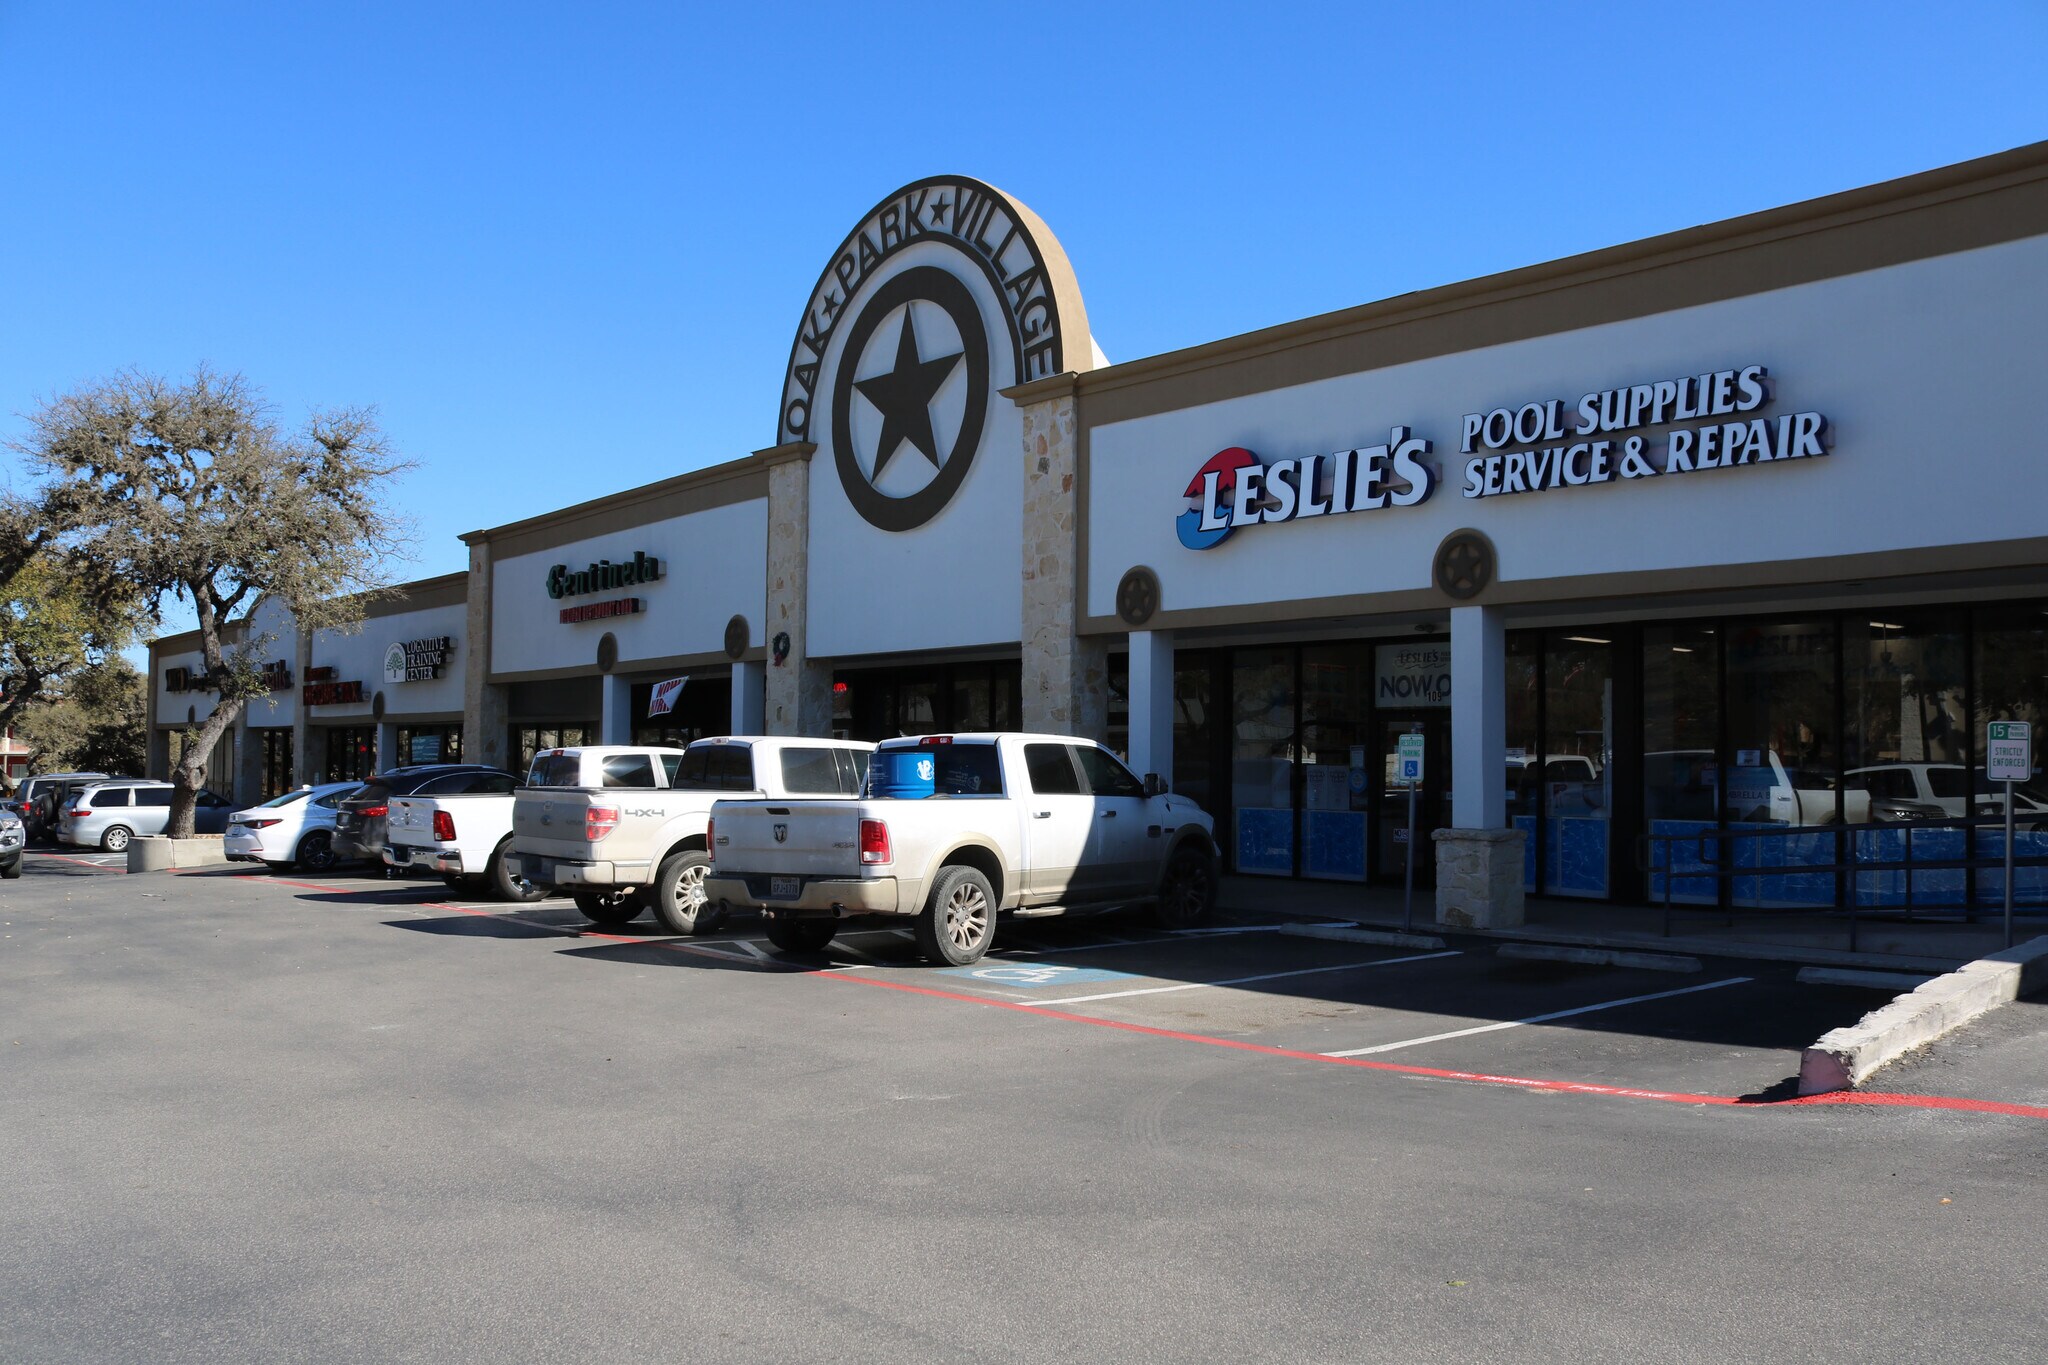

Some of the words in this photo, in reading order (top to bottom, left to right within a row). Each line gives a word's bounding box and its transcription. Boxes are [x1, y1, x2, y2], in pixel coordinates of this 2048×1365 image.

[785, 309, 832, 435] OAK
[835, 187, 929, 298] PARK
[952, 186, 1056, 381] VILLAGE
[1460, 399, 1566, 454] POOL
[1576, 364, 1768, 436] SUPPLIES
[1462, 441, 1620, 499] SERVICE
[1619, 434, 1664, 479] &
[1665, 410, 1829, 473] REPAIR
[1198, 426, 1435, 532] LESLIE'S
[546, 551, 659, 599] Centinela
[406, 636, 446, 654] COGNITIVE
[406, 650, 442, 668] TRAINING
[1400, 650, 1439, 664] LESLIE'S
[406, 666, 434, 681] CENTER
[1380, 675, 1433, 698] NOW
[1427, 691, 1442, 702] 109
[1993, 725, 2005, 737] 15
[1995, 747, 2023, 756] STRICTLY
[1993, 758, 2025, 767] ENFORCED
